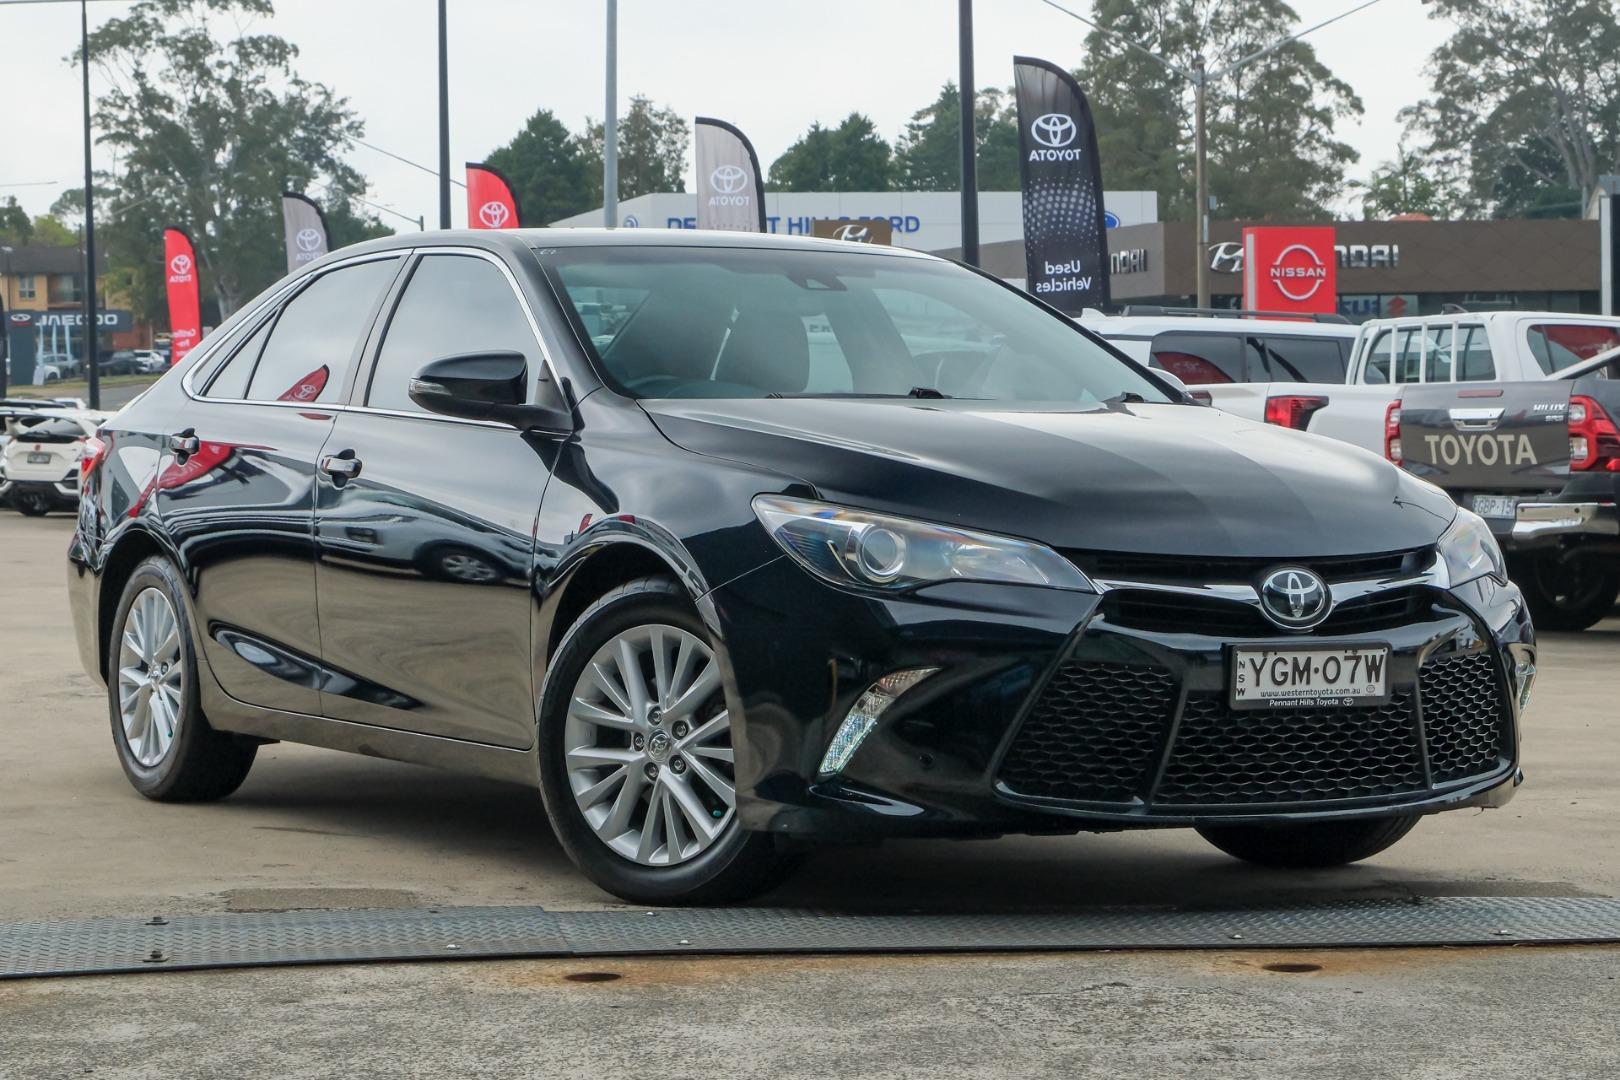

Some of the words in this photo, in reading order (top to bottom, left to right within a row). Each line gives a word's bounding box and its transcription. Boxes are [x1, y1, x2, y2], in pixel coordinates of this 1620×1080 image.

[1270, 267, 1326, 277] NISSAN
[1424, 434, 1538, 466] TOYOTA
[1260, 688, 1361, 698] www.westerntoyota.com.au
[1269, 699, 1298, 707] Pennant
[1299, 698, 1315, 706] Hills
[1316, 698, 1339, 707] Toyota
